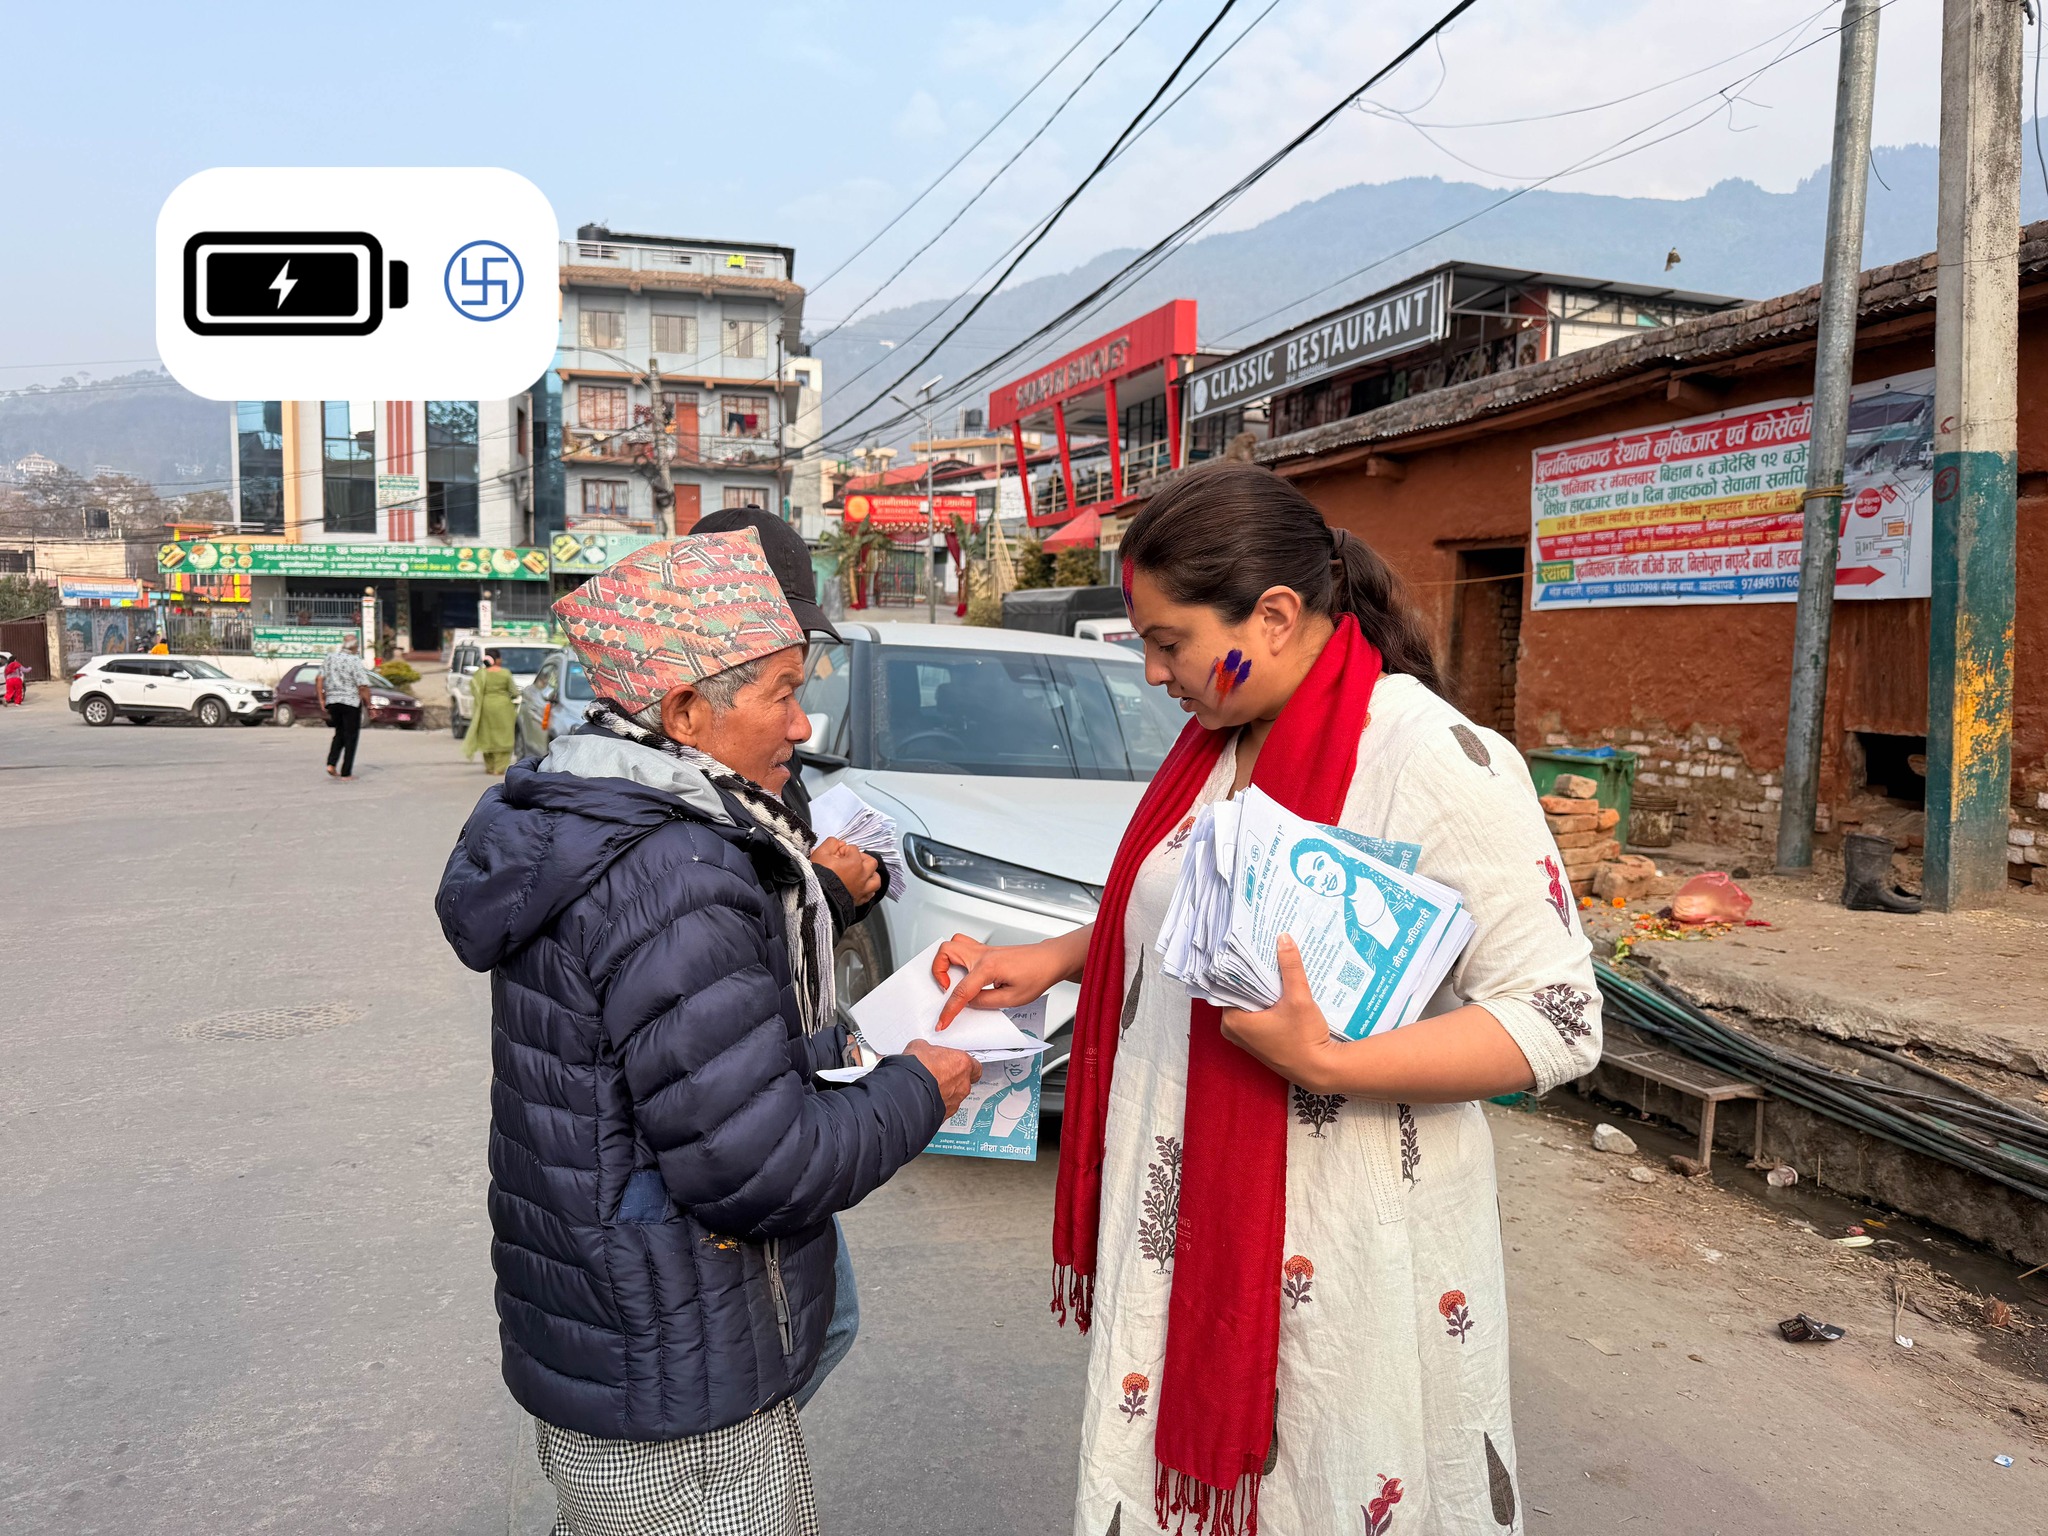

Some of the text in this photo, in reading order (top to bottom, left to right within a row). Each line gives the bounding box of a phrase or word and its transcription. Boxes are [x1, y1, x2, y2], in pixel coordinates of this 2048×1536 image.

[1211, 290, 1428, 400] CLASSIC RESTAURANT
[1615, 436, 1651, 465] रैथाने
[1653, 429, 1722, 463] कृषिबजार
[1725, 420, 1748, 447] एवं
[1752, 406, 1812, 442] कोसेली
[1600, 480, 1608, 491] र
[1660, 463, 1692, 482] बिहान
[1696, 463, 1704, 478] ६
[1708, 452, 1757, 475] बजेदेखि
[1761, 452, 1778, 468] १२
[1783, 443, 1809, 465] बजे
[1643, 485, 1664, 503] दिन
[1667, 477, 1717, 501] ग्राहकको
[1721, 475, 1761, 495] सेवामा
[1777, 549, 1802, 569] हाटब
[1741, 575, 1800, 590] 9749491766
[1392, 908, 1431, 968] नीशा अधिकारी
[980, 1142, 1031, 1155] नीशा अधिकारी
